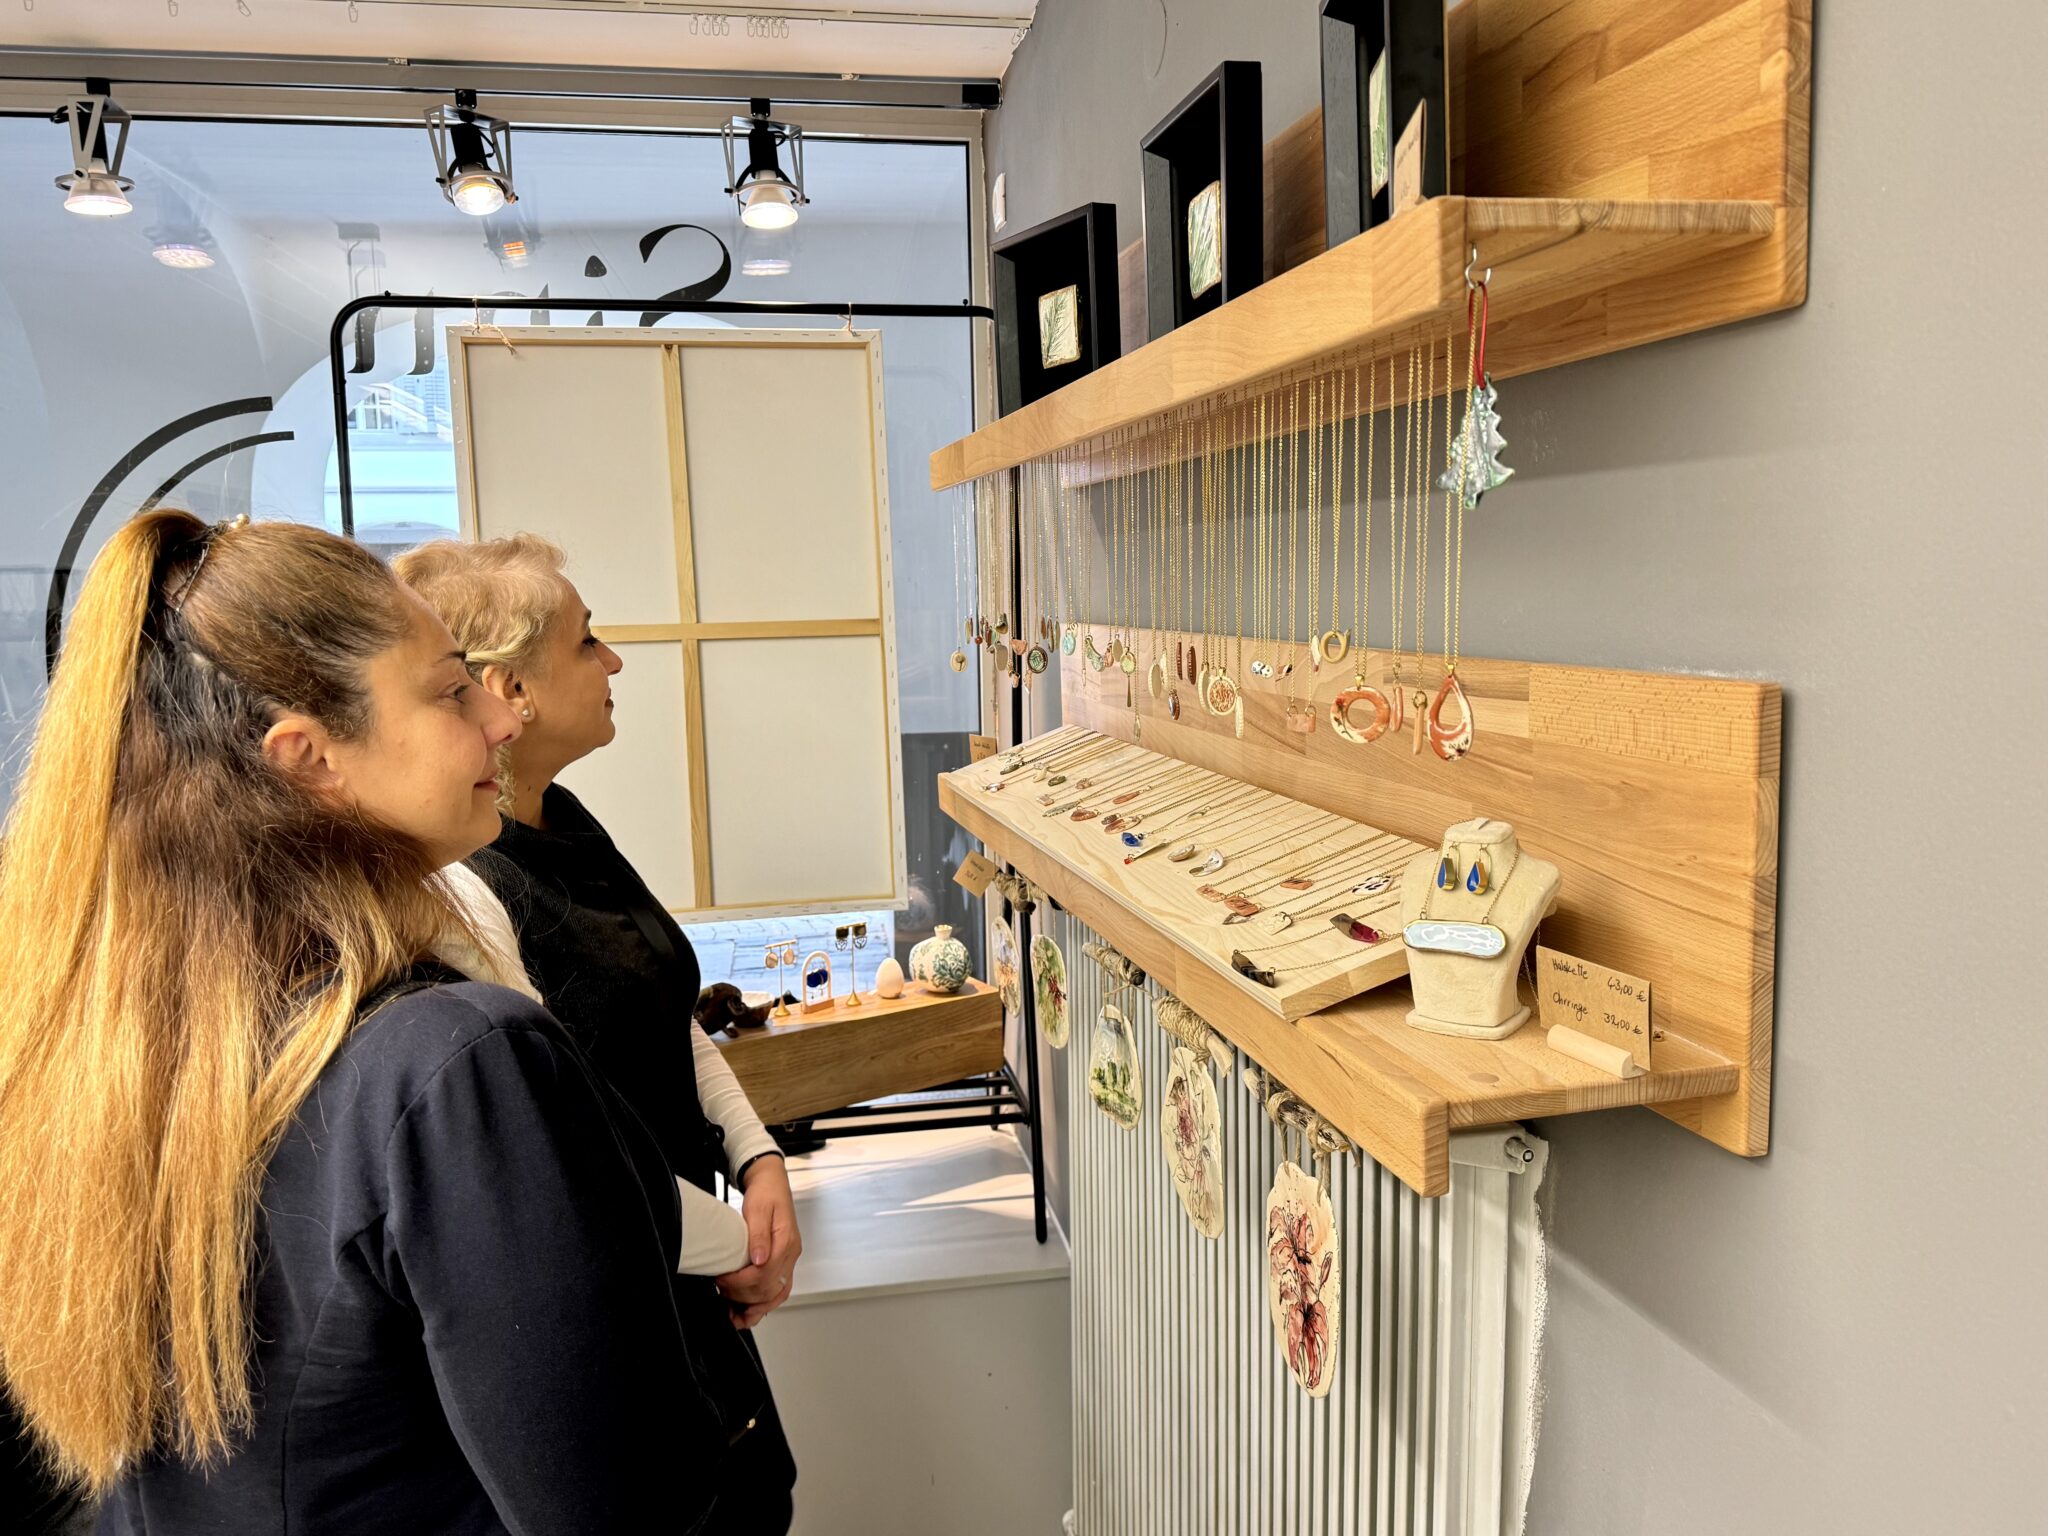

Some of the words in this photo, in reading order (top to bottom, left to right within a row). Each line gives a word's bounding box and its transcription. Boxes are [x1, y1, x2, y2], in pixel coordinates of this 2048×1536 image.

[1552, 958, 1588, 980] Halskette
[1607, 976, 1633, 995] 43,00
[1636, 990, 1648, 1003] €
[1552, 991, 1588, 1022] Ohrringe
[1603, 1012, 1631, 1032] 32,00
[1632, 1025, 1644, 1035] €
